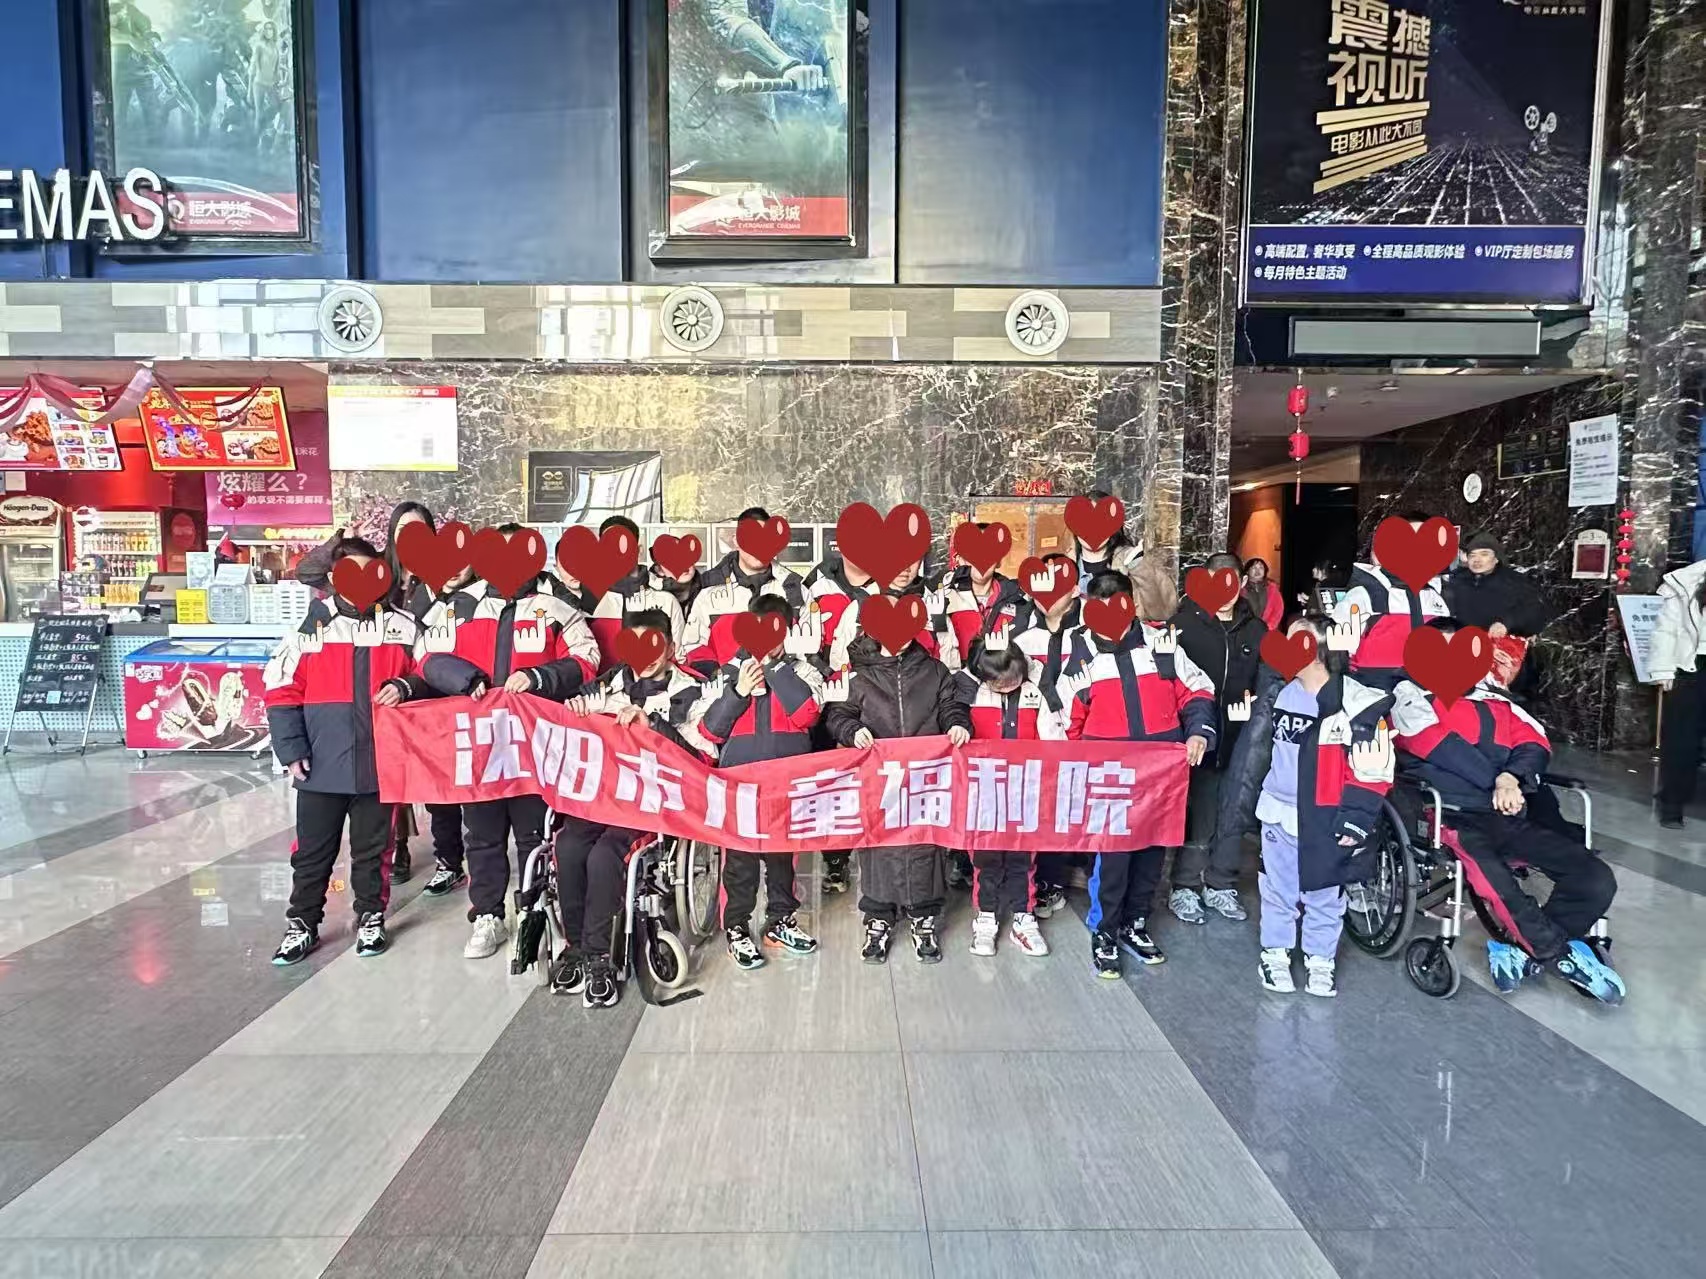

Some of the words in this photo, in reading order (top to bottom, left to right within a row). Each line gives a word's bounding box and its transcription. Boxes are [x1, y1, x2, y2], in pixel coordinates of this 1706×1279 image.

[1328, 0, 1430, 57] 震撼
[1327, 51, 1429, 106] 视听
[1331, 119, 1422, 154] 电影从此大不同
[1263, 265, 1347, 281] 每月特色主题活动
[1371, 243, 1465, 259] 全程高品质观影体验
[1484, 244, 1574, 260] VIP厅定制包场服务
[455, 708, 1136, 838] 沈阳市儿童福利院
